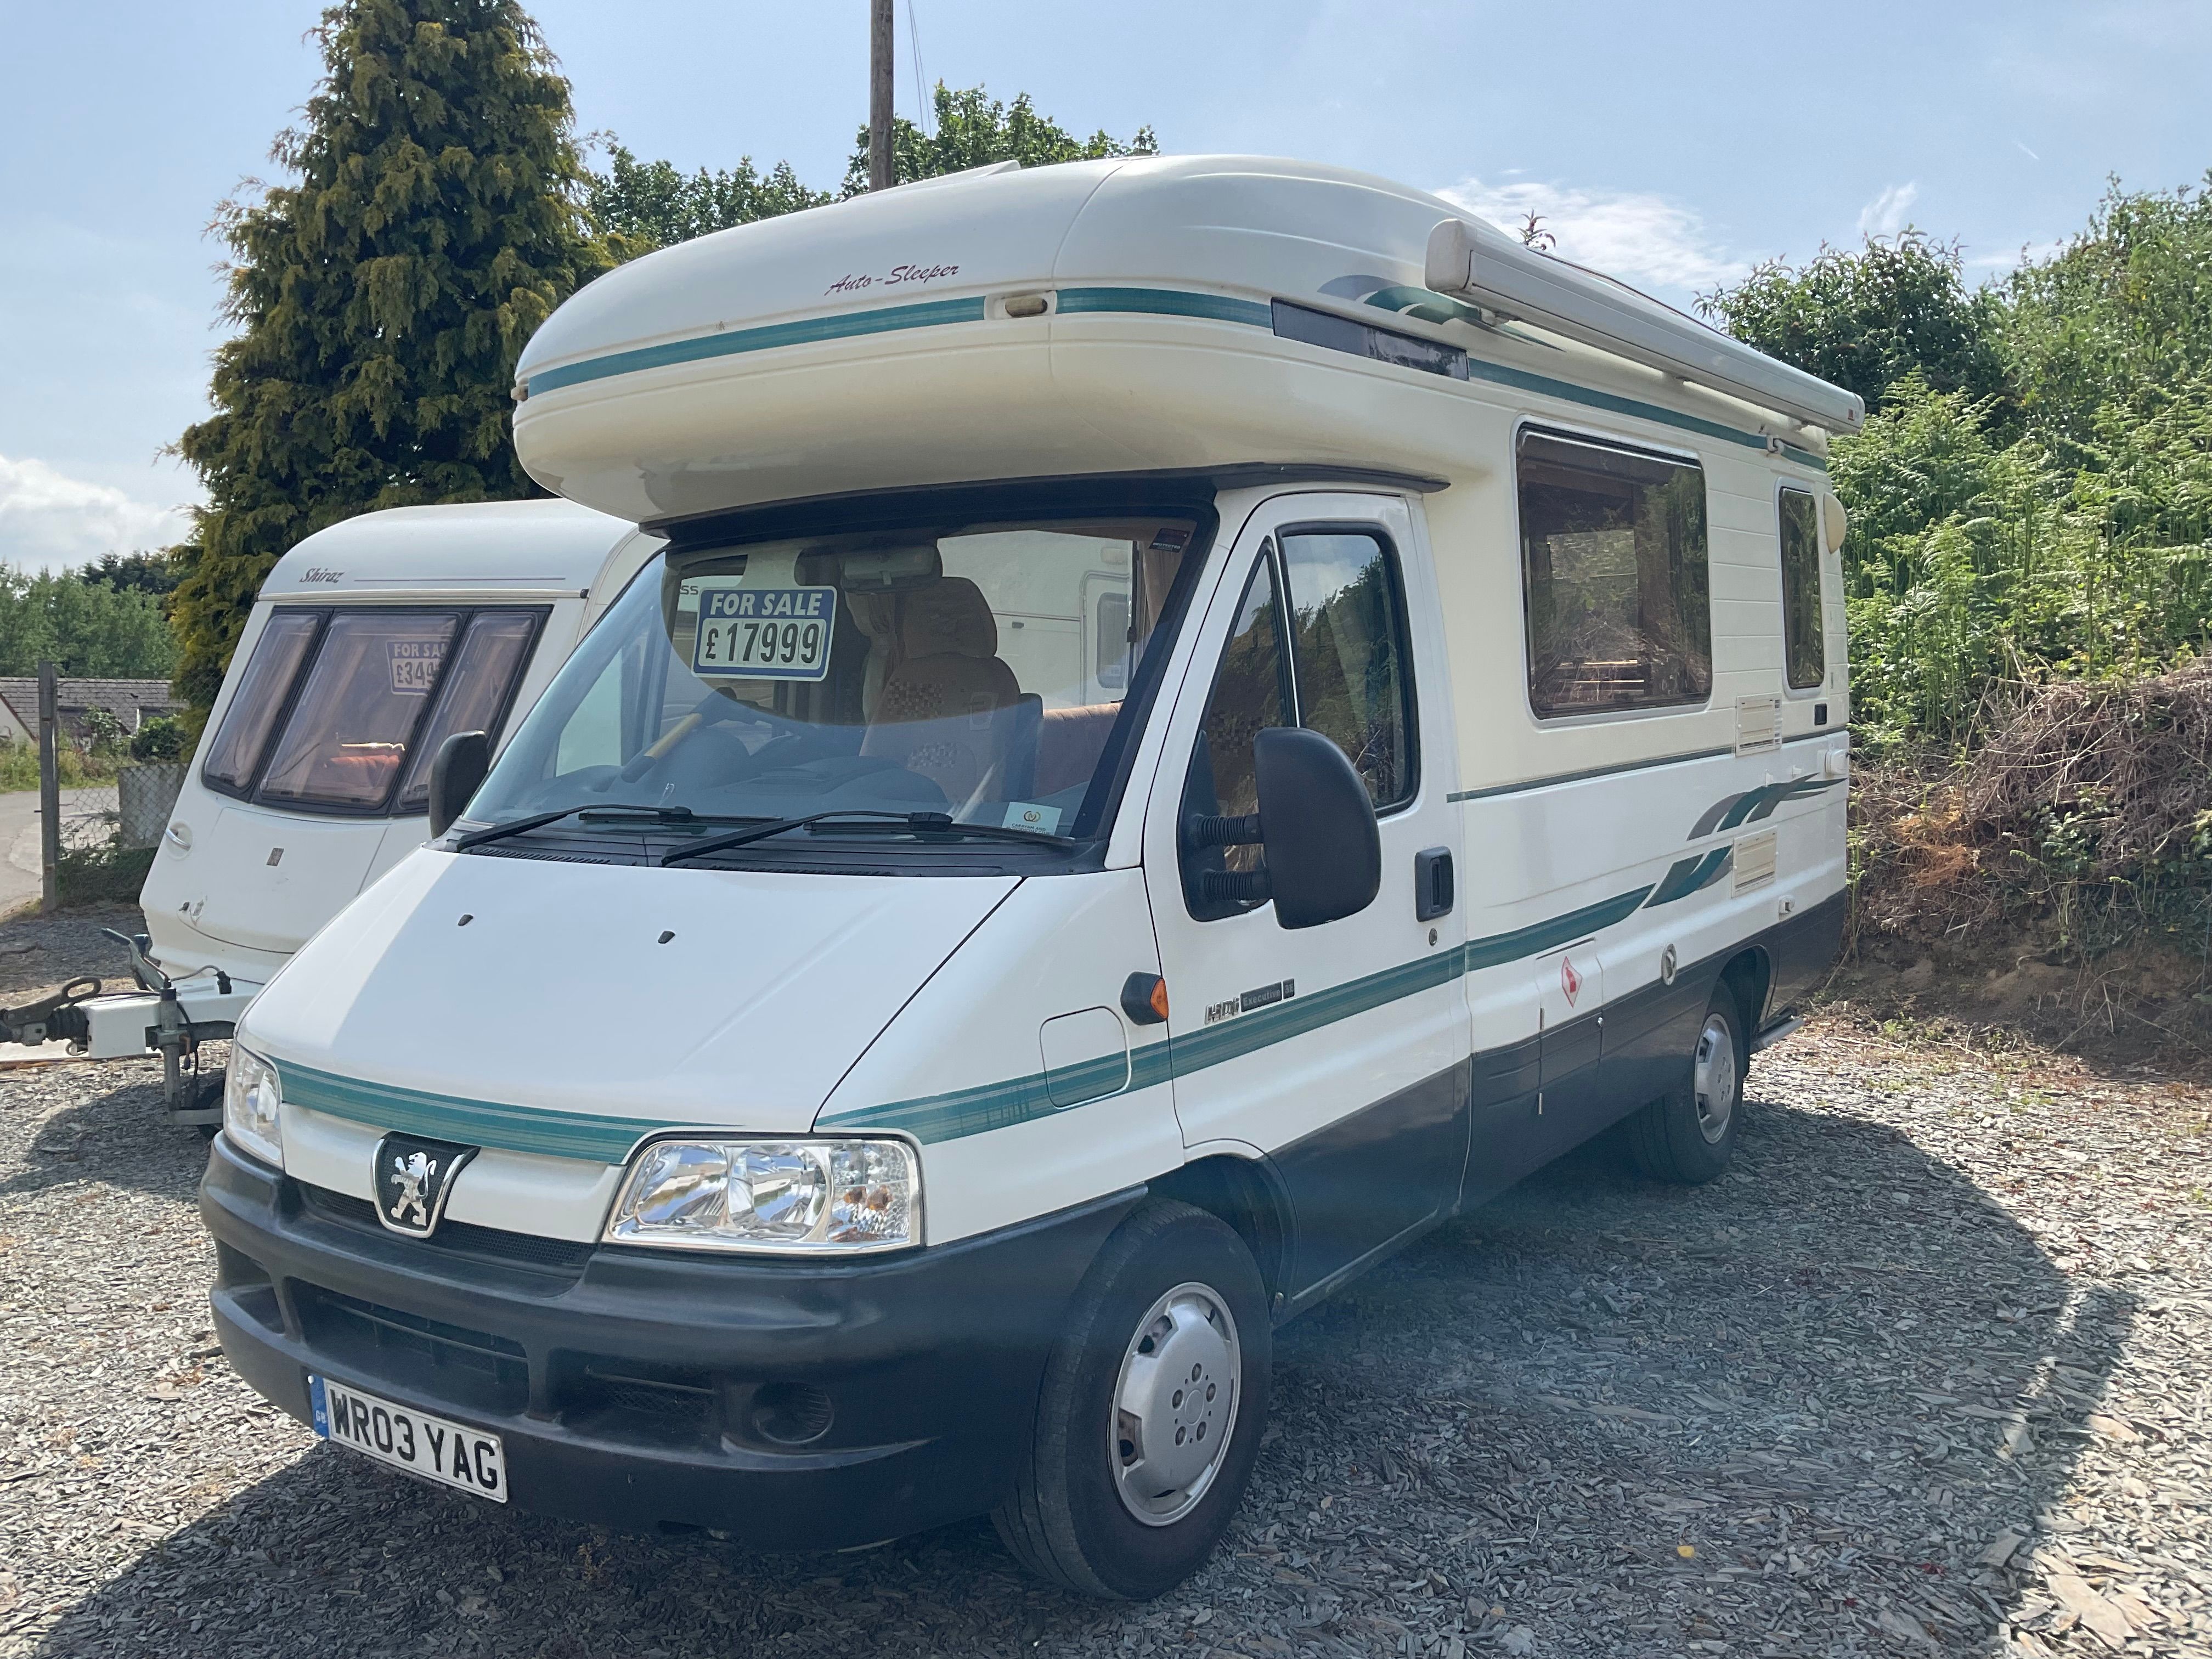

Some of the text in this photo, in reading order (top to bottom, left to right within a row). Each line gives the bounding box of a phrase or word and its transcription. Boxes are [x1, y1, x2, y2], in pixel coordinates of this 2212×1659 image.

[824, 264, 959, 296] Auto-Sleeper
[299, 568, 345, 583] Shiraz
[710, 593, 822, 616] FOR SALE
[394, 644, 419, 657] FOR
[705, 623, 820, 664] £17999
[1243, 989, 1280, 1007] Executive
[315, 1409, 326, 1424] GB
[330, 1389, 498, 1490] WR03 YAG
